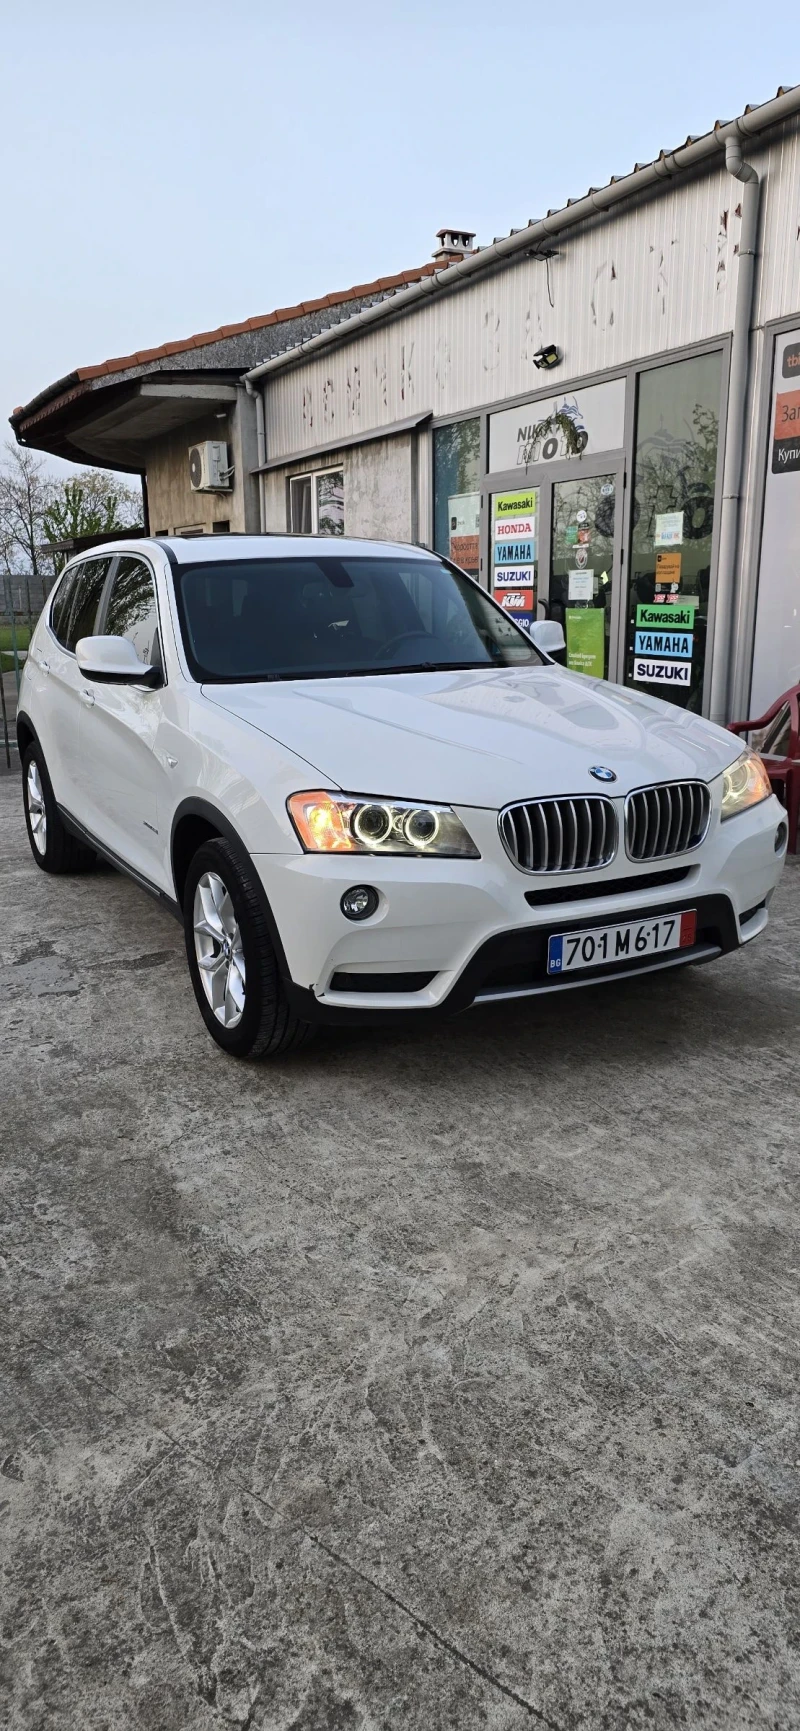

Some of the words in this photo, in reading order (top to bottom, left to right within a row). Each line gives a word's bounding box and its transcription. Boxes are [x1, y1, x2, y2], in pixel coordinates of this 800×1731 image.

[497, 497, 533, 512] Kawasaki
[497, 523, 532, 535] HONDA
[497, 544, 532, 561] YAMAHA
[497, 571, 531, 581] SUZUKI
[501, 592, 526, 608] KTM
[640, 607, 690, 624] Kawasaki
[639, 635, 689, 654] YAMAHA
[637, 663, 688, 681] SUZUKI
[550, 958, 561, 969] BG
